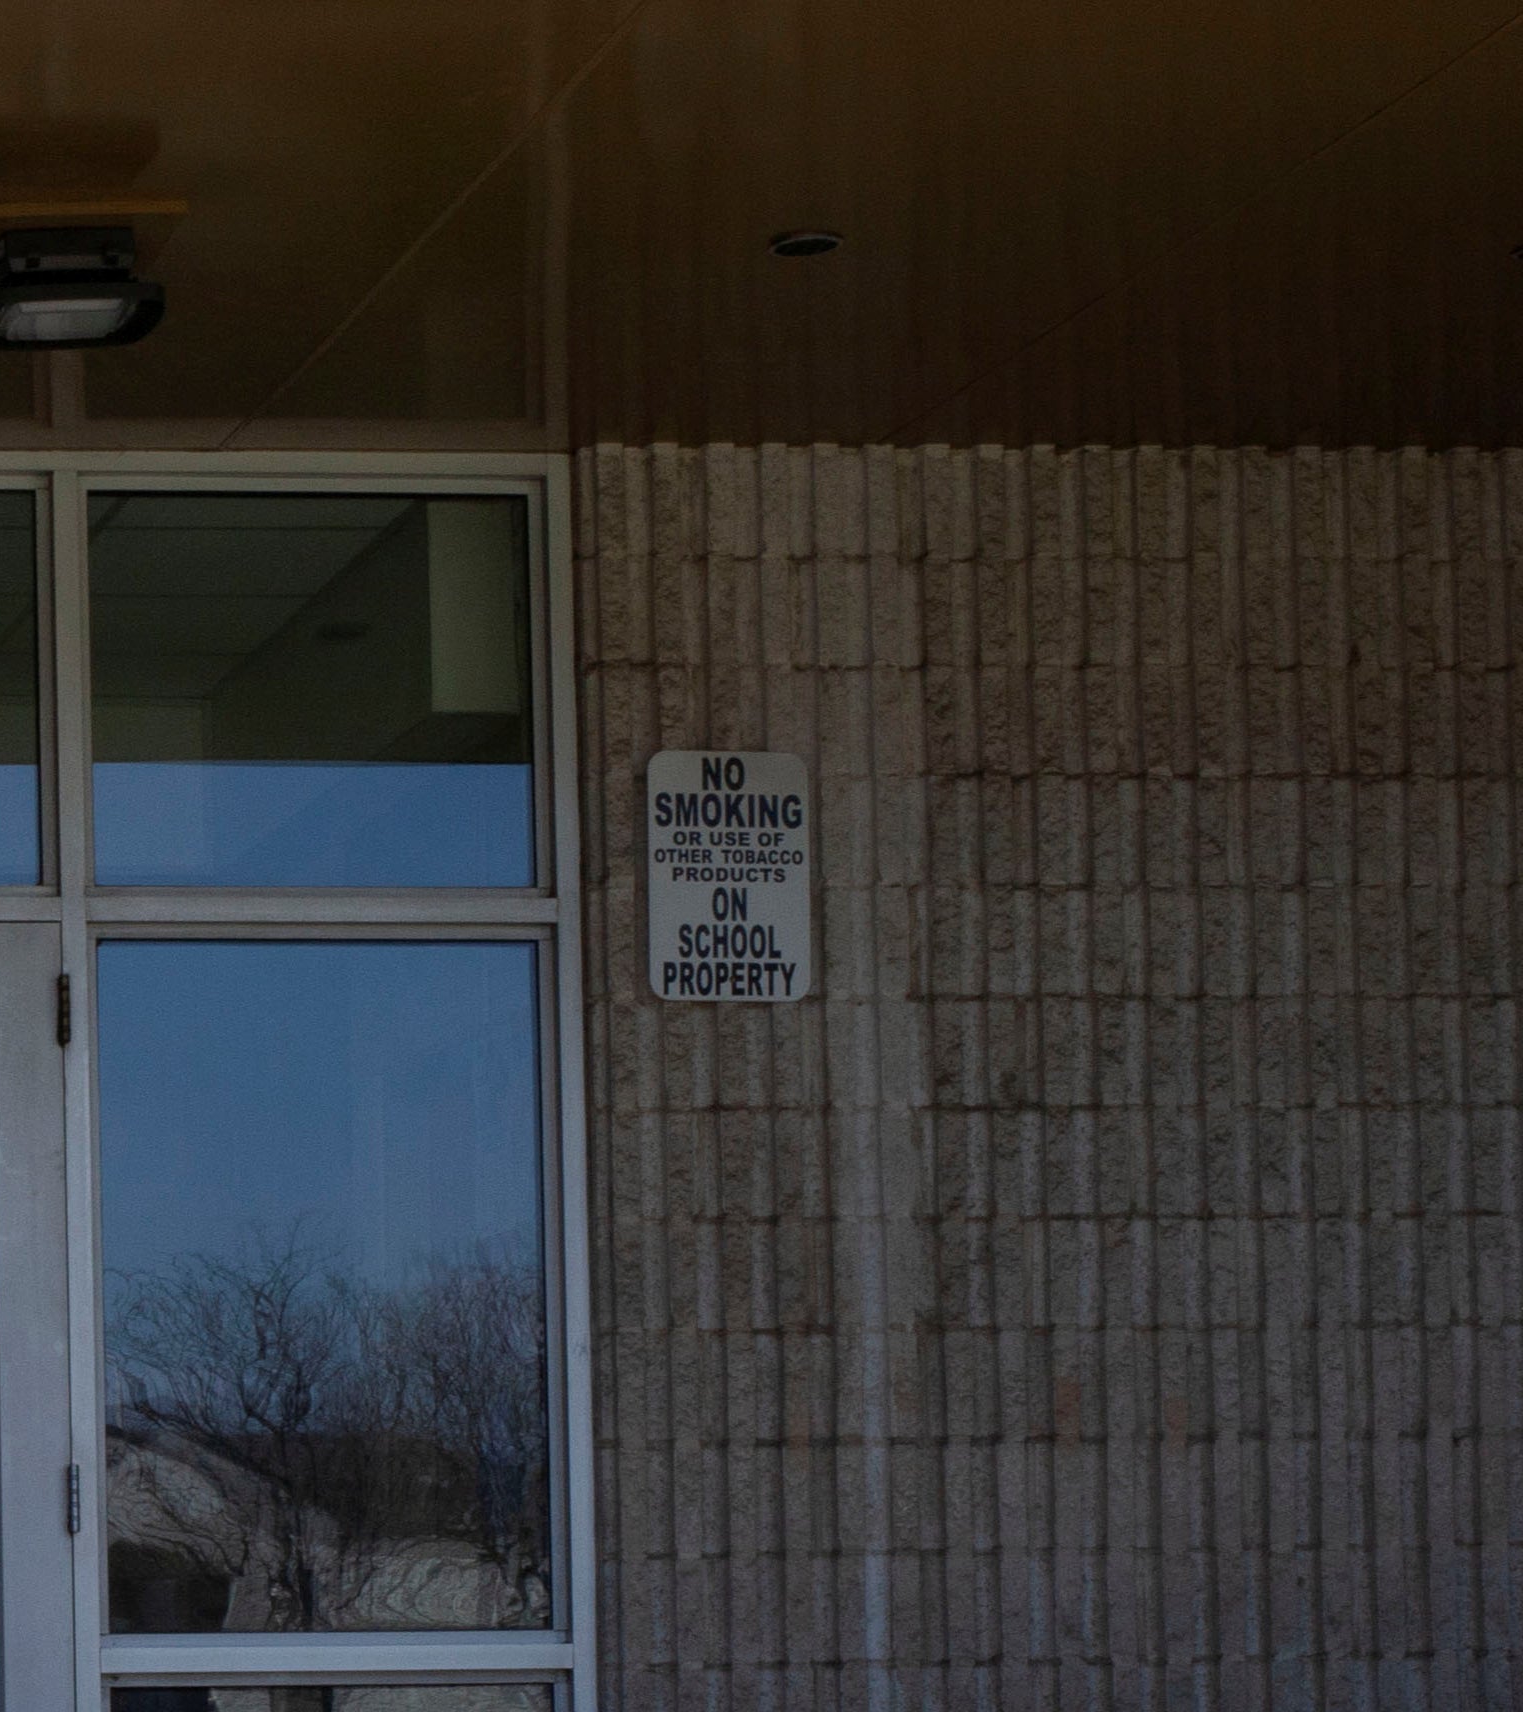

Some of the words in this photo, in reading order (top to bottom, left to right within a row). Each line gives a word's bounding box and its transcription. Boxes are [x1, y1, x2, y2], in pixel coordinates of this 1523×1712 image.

[701, 756, 745, 791] NO
[654, 791, 803, 829] SMOKING
[672, 831, 702, 846] OR
[709, 832, 750, 847] USE
[757, 832, 785, 847] OF
[654, 849, 713, 864] OTHER
[721, 850, 803, 865] TOBACCO
[671, 866, 786, 883] PRODUCTS
[712, 886, 748, 922] ON
[677, 923, 782, 959] SCHOOL
[662, 962, 797, 996] PROPERTY
